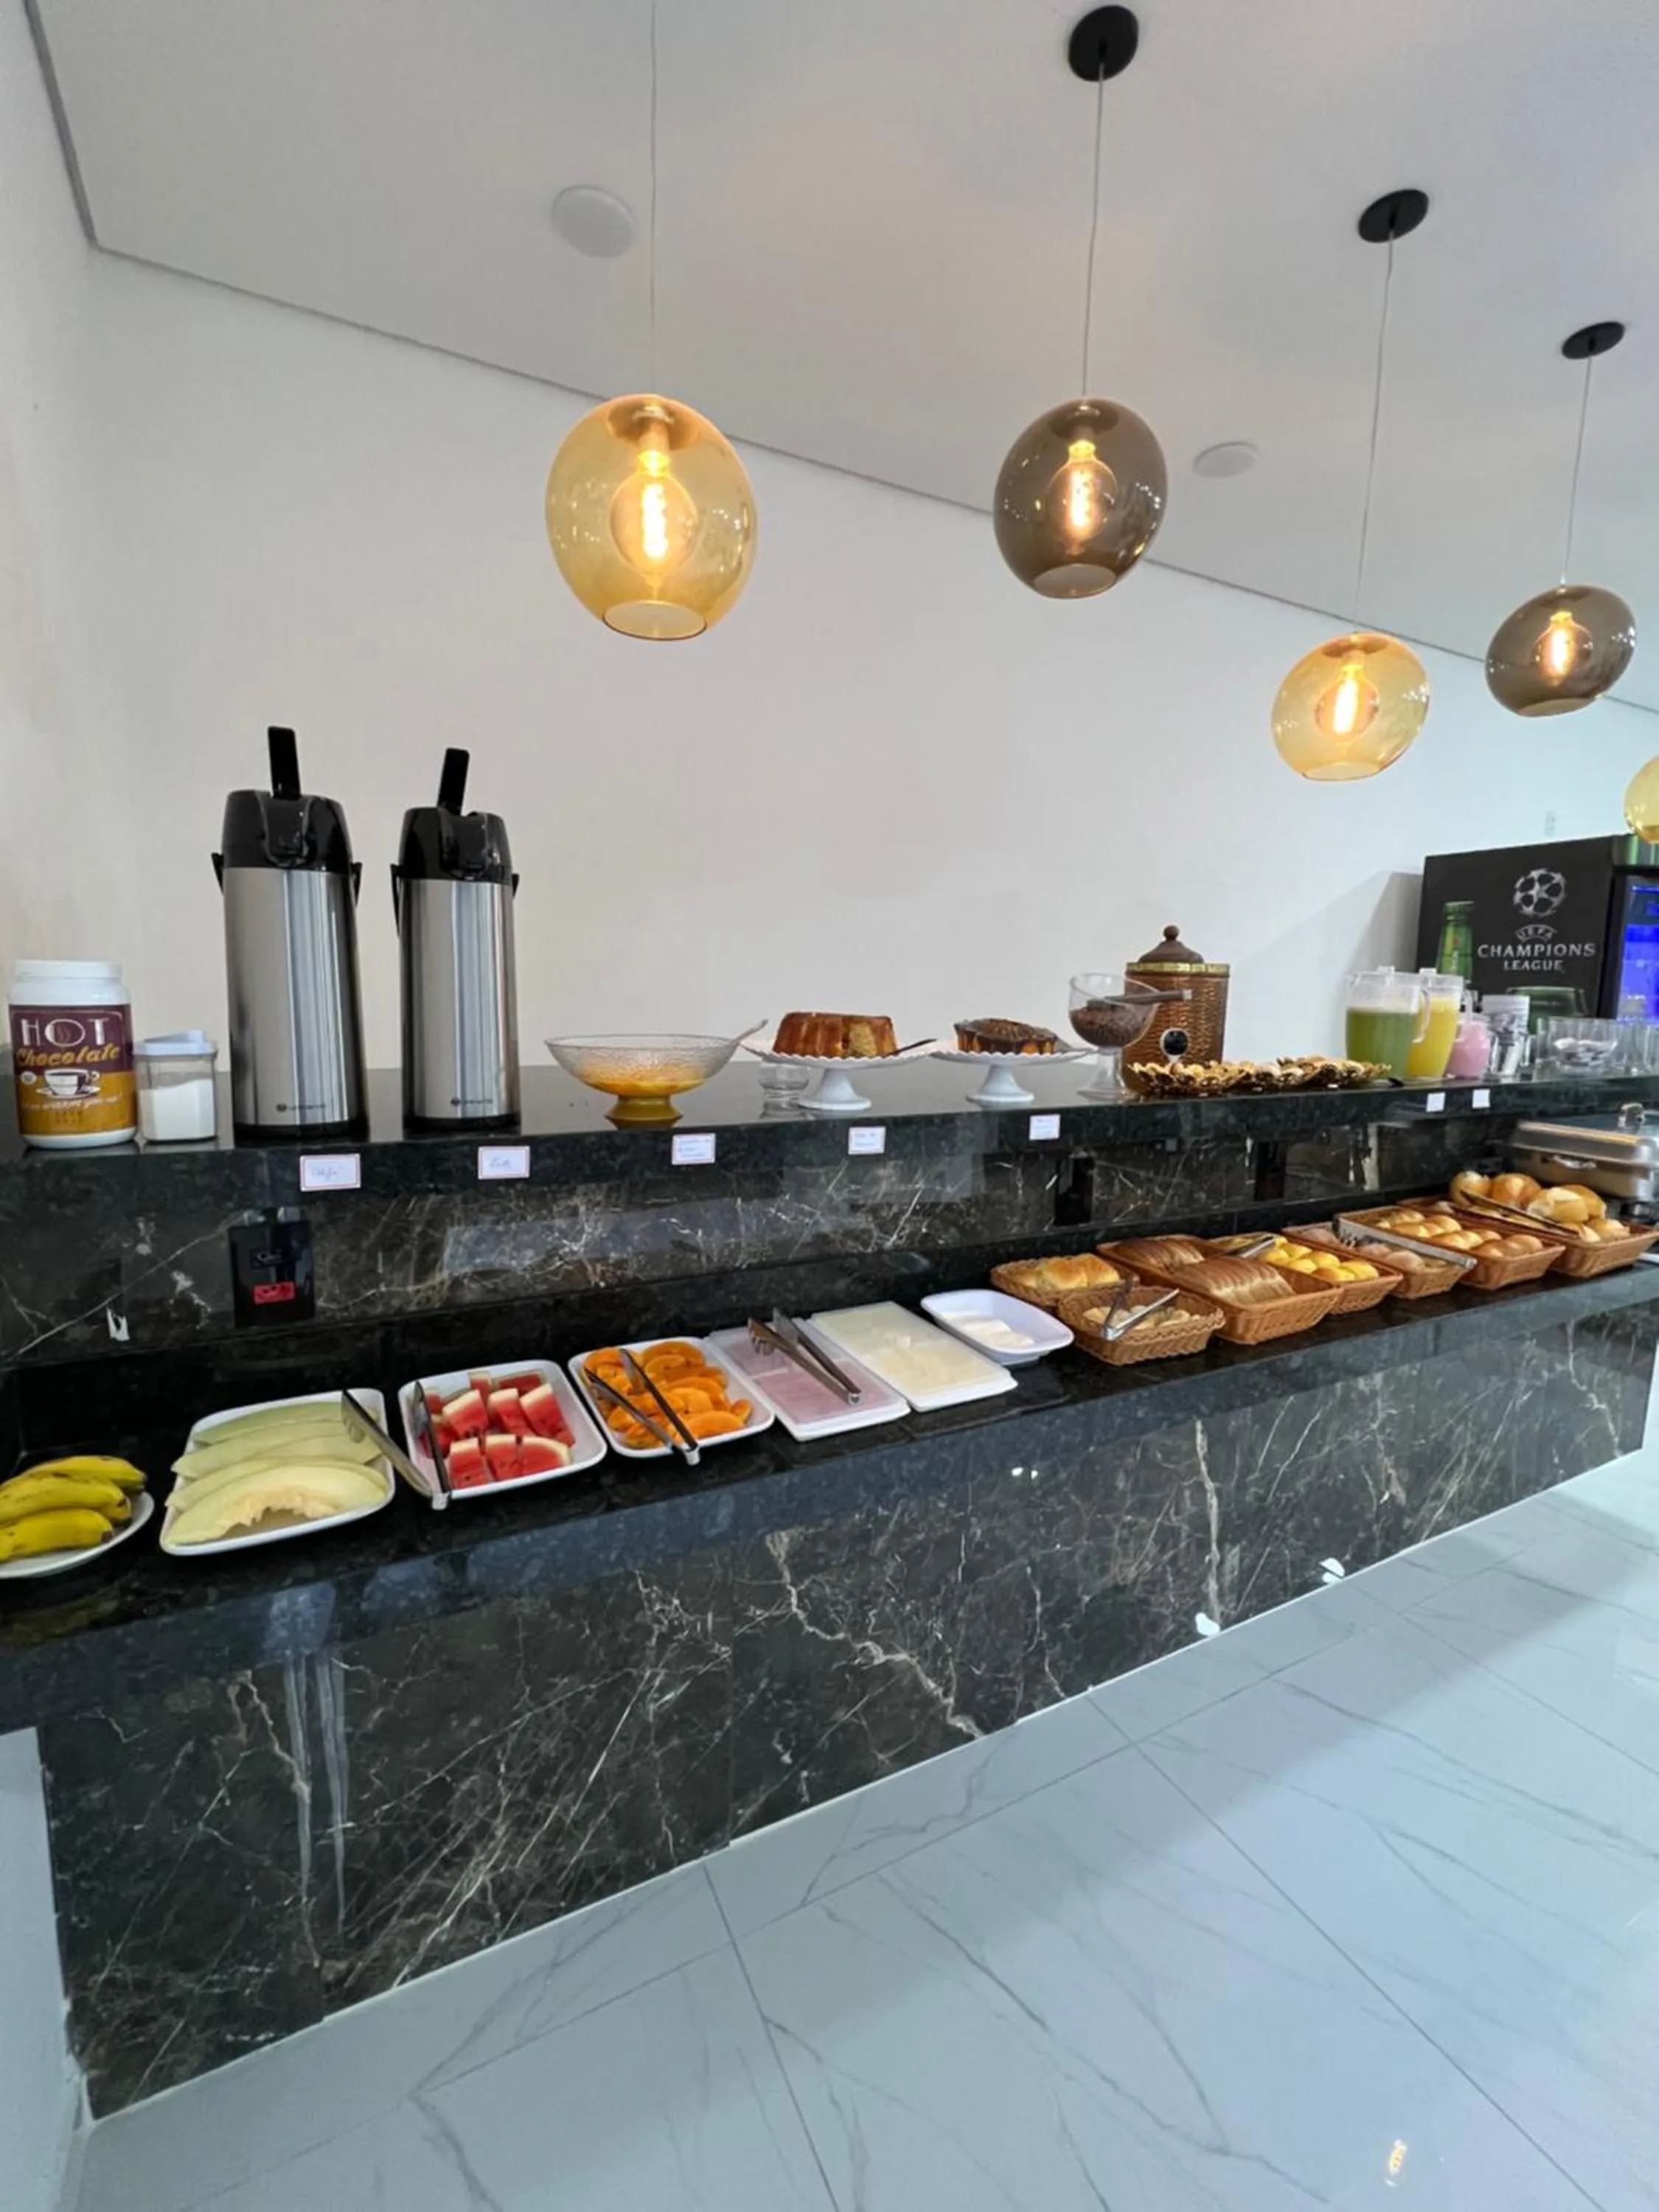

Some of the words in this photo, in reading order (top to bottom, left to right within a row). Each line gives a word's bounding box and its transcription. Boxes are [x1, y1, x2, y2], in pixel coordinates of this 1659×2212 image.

[1516, 925, 1554, 941] UEFA
[1477, 943, 1596, 958] CHAMPIONS
[1503, 959, 1564, 971] LEAGUE
[21, 1018, 110, 1048] HOT
[16, 1043, 120, 1066] Chocolate
